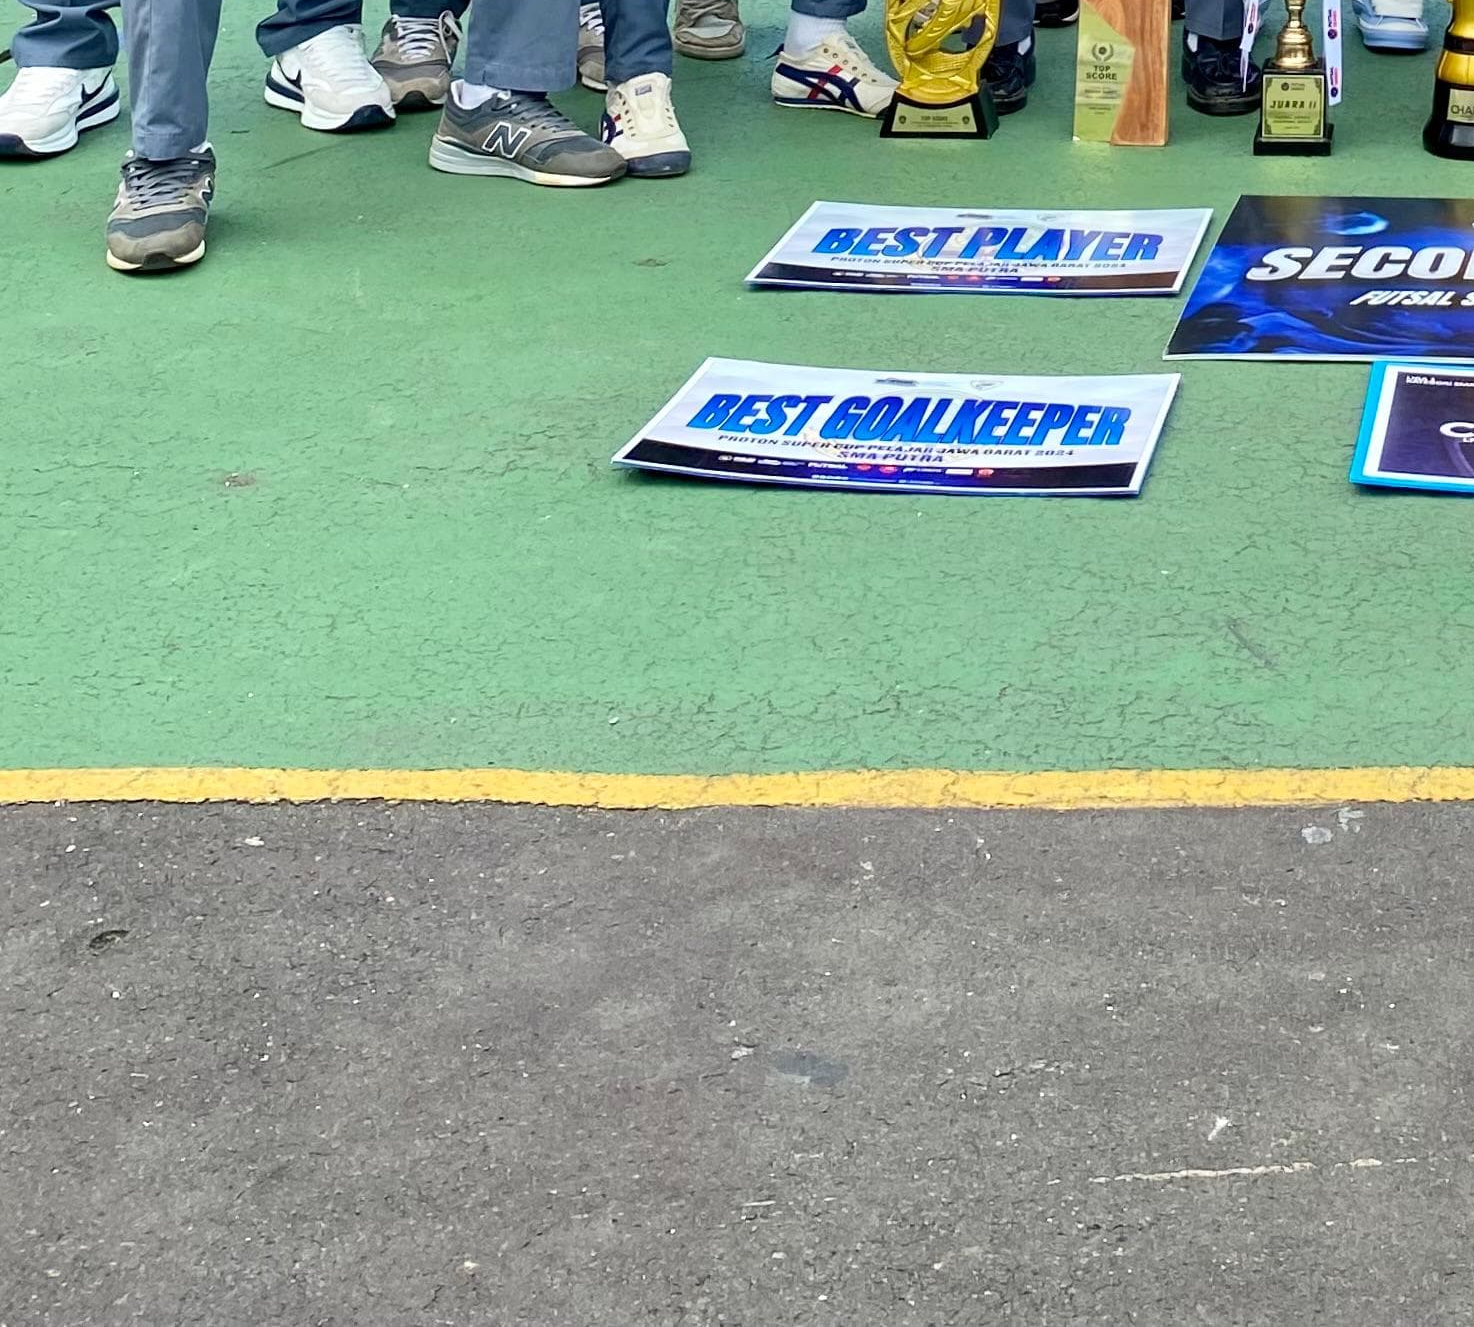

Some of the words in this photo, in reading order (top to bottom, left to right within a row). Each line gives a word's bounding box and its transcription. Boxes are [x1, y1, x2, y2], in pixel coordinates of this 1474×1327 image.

[1085, 72, 1118, 81] SCORE
[1093, 65, 1111, 73] TOP
[1269, 100, 1306, 109] JUARA
[482, 121, 532, 158] N
[811, 226, 965, 259] BEST
[958, 226, 1164, 261] PLAYER
[1350, 290, 1456, 307] FUTSAL
[686, 393, 836, 437] BEST
[819, 395, 1132, 446] GOALKEEPER
[718, 434, 778, 446] PROTON
[780, 438, 831, 449] SUPER
[866, 443, 934, 453] PELAJAR
[935, 447, 980, 455] JAWA
[981, 448, 1031, 456] BARAT
[1033, 449, 1076, 457] 2024
[837, 450, 878, 460] SMA
[882, 452, 944, 463] PUTRA
